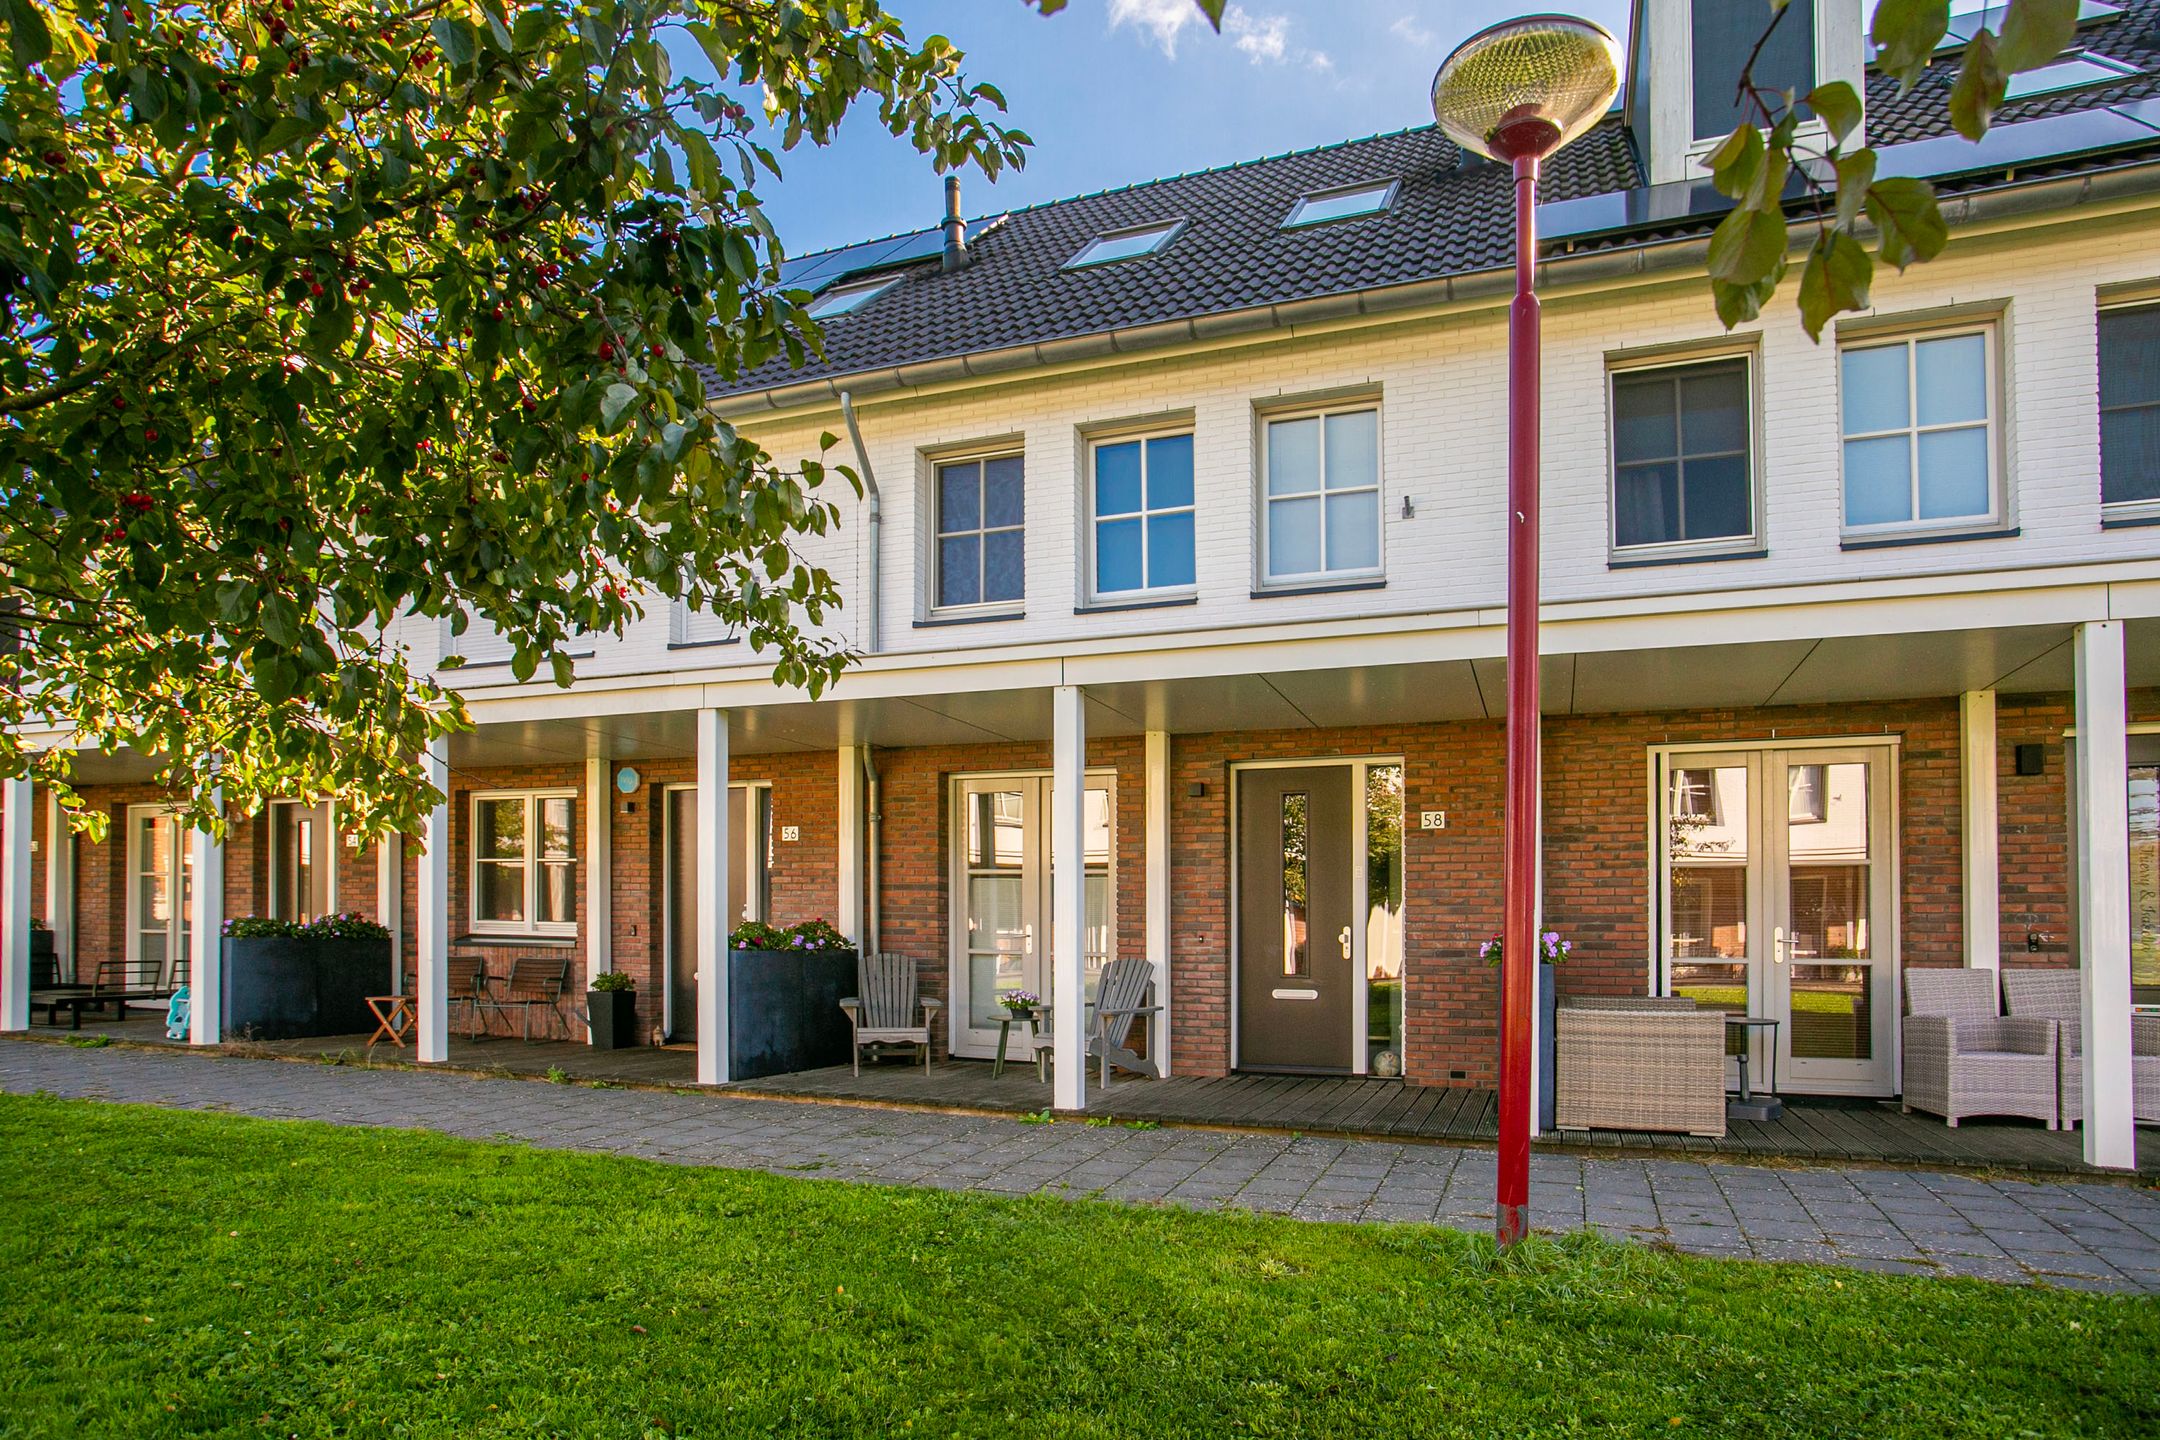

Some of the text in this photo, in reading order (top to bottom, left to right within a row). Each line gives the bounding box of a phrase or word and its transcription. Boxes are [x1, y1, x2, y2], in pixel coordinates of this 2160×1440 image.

[1423, 813, 1443, 827] 58
[783, 828, 797, 839] 56
[347, 836, 357, 846] 54
[2132, 845, 2155, 886] Thierry
[2139, 889, 2156, 903] &
